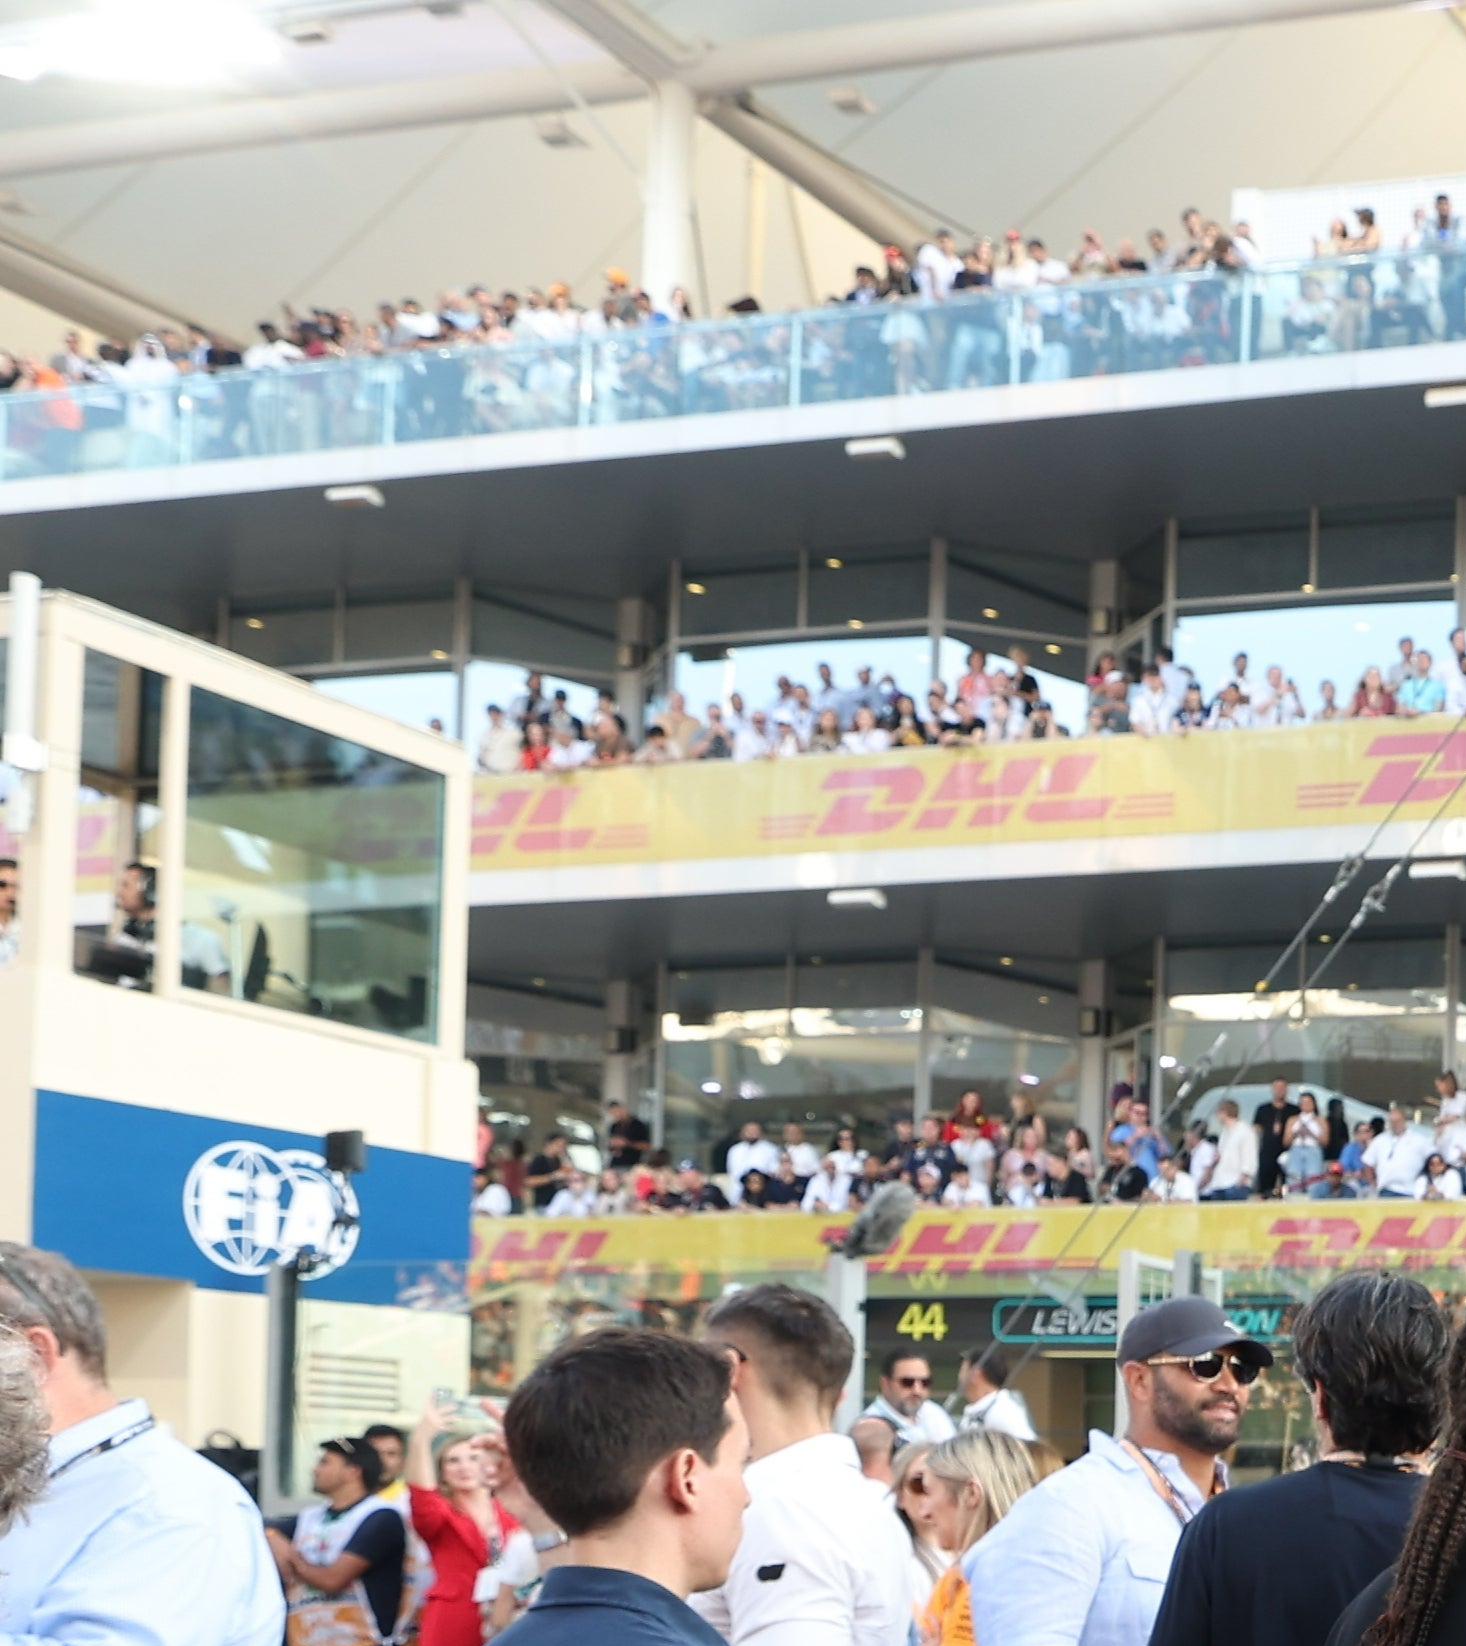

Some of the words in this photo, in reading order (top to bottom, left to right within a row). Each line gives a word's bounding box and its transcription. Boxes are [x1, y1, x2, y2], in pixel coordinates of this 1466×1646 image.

[816, 754, 1117, 837] DHL
[897, 1302, 948, 1341] 44
[1031, 1307, 1118, 1336] LEWIS
